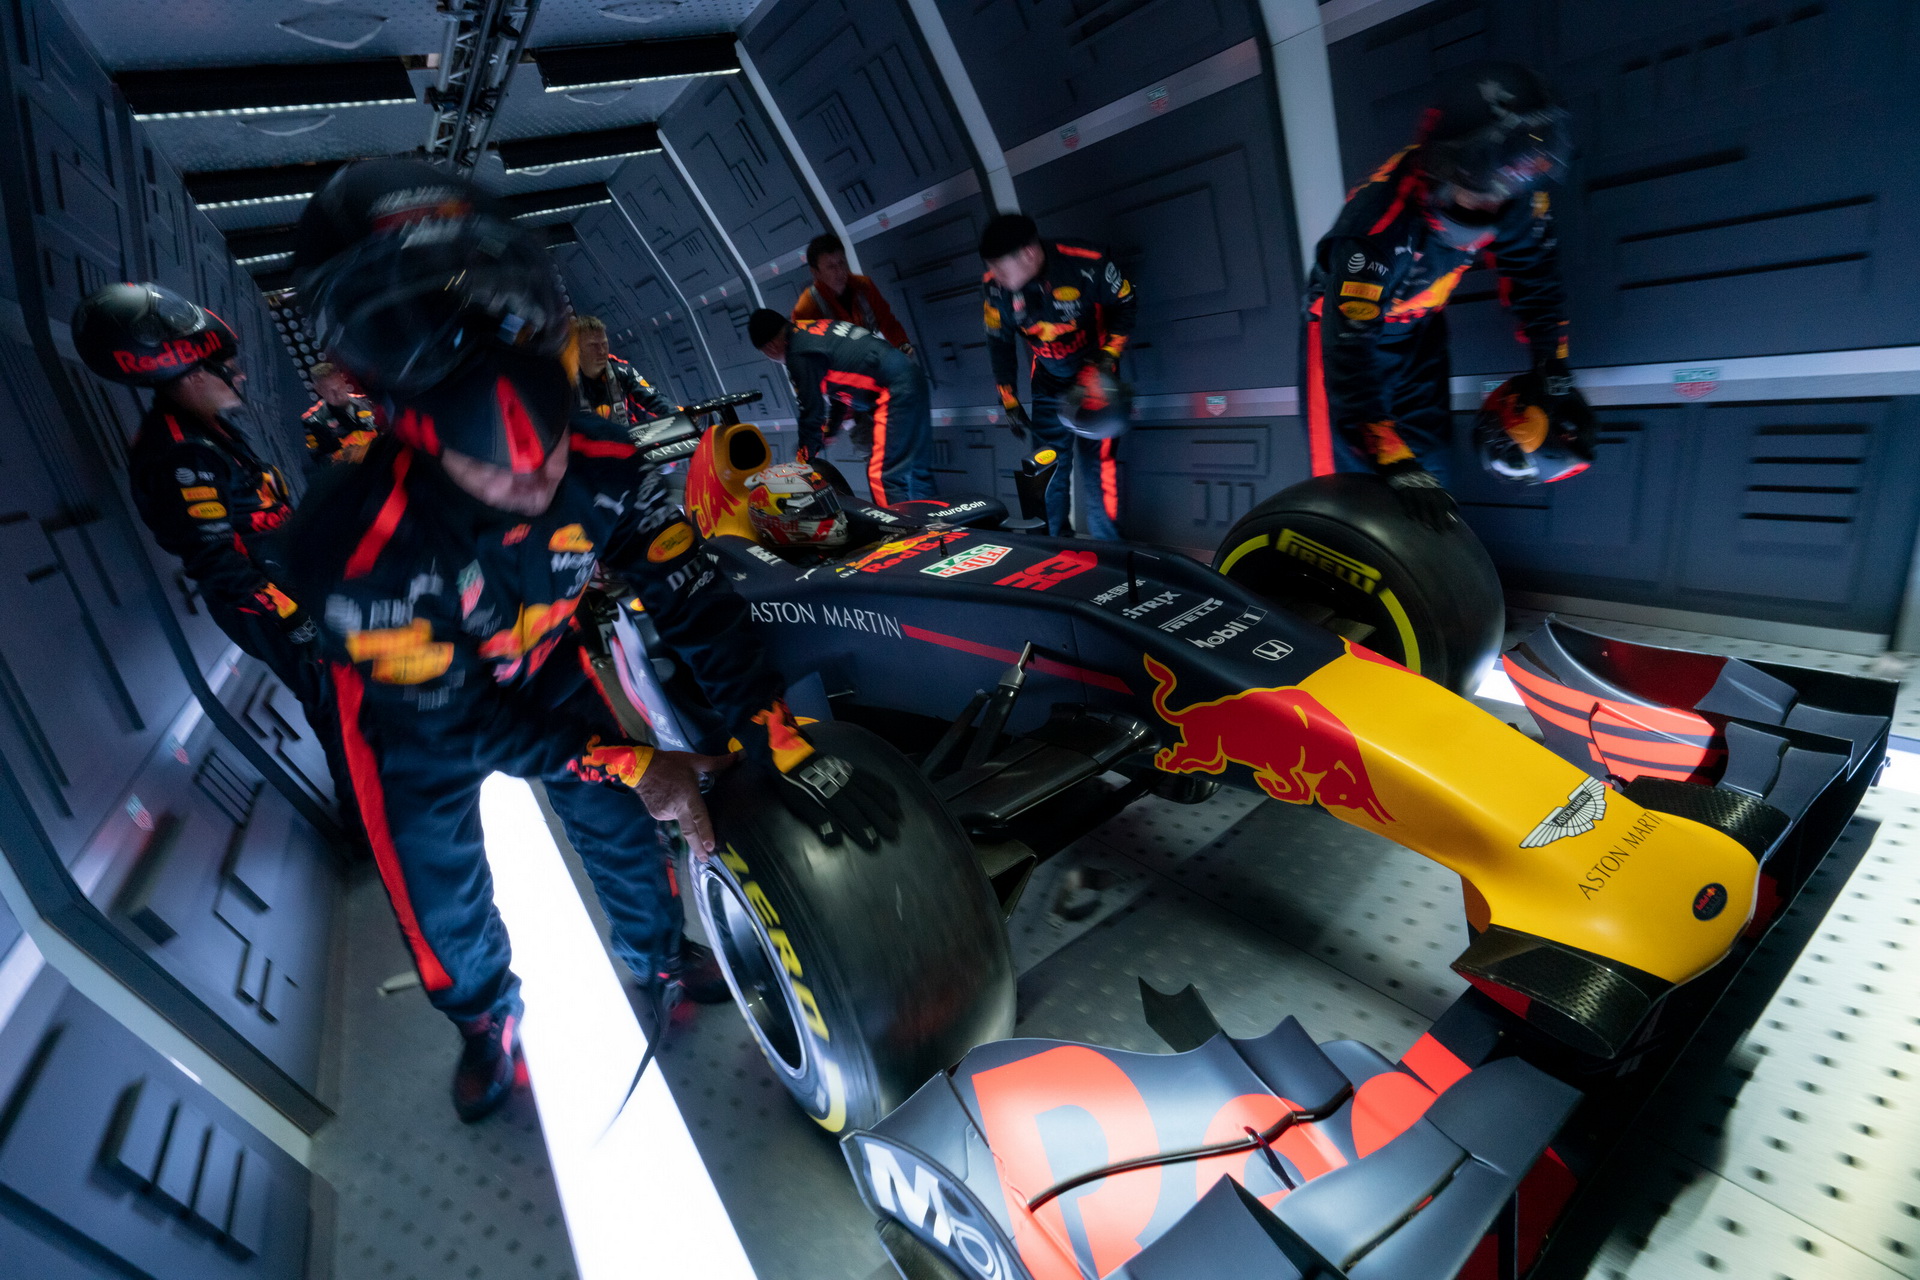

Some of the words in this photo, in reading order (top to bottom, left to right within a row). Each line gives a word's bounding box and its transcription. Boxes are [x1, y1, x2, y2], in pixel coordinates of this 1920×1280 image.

[112, 342, 179, 374] Red
[173, 330, 223, 364] Bull
[861, 550, 921, 573] Red
[914, 531, 970, 552] Bull
[924, 545, 998, 573] TAG
[939, 547, 1009, 576] HEUER
[992, 550, 1098, 592] 33
[1275, 528, 1383, 596] PIRELLI
[750, 602, 817, 624] ASTON
[822, 604, 903, 640] MARTIN
[1122, 591, 1182, 619] ITRIX
[1577, 845, 1631, 901] ASTON
[1621, 810, 1663, 850] MARTI
[718, 842, 831, 1043] ZERO
[863, 1142, 1015, 1280] Mo
